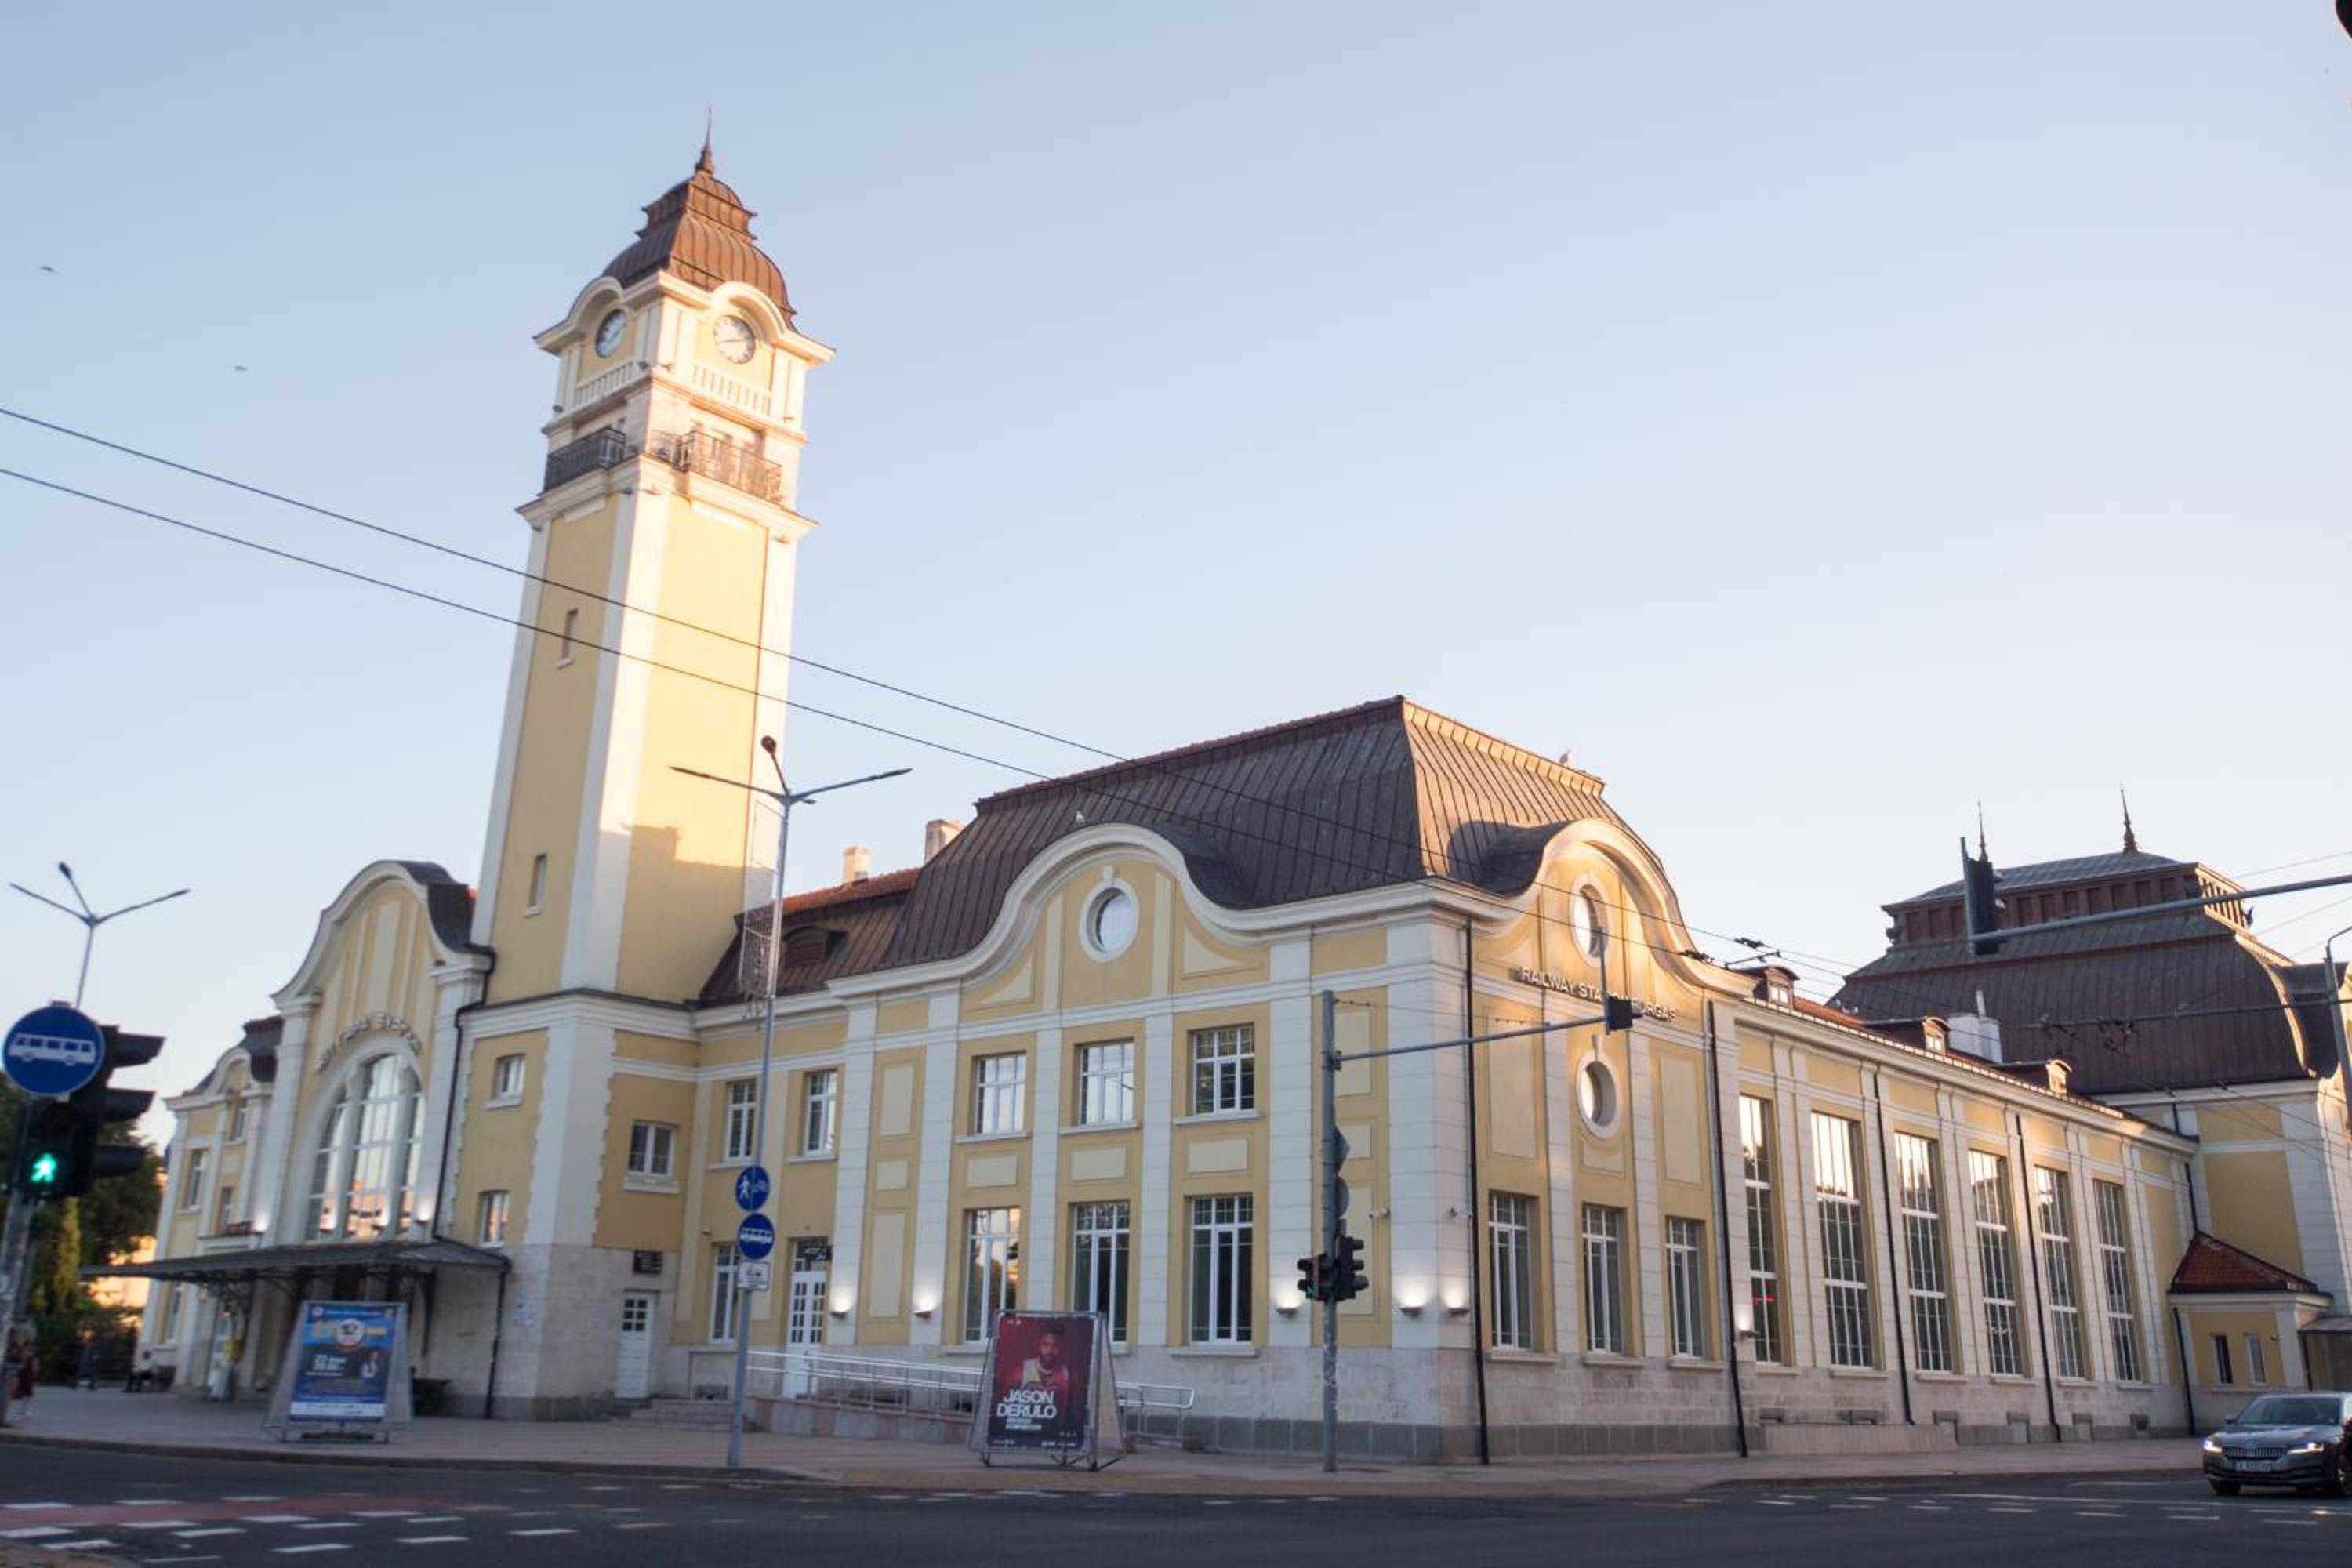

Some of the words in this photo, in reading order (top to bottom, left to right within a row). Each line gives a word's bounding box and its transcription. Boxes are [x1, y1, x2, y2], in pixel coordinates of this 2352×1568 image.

[1521, 966, 1575, 993] RAILWAY
[1004, 1390, 1054, 1404] JASON
[996, 1403, 1057, 1418] DERULO
